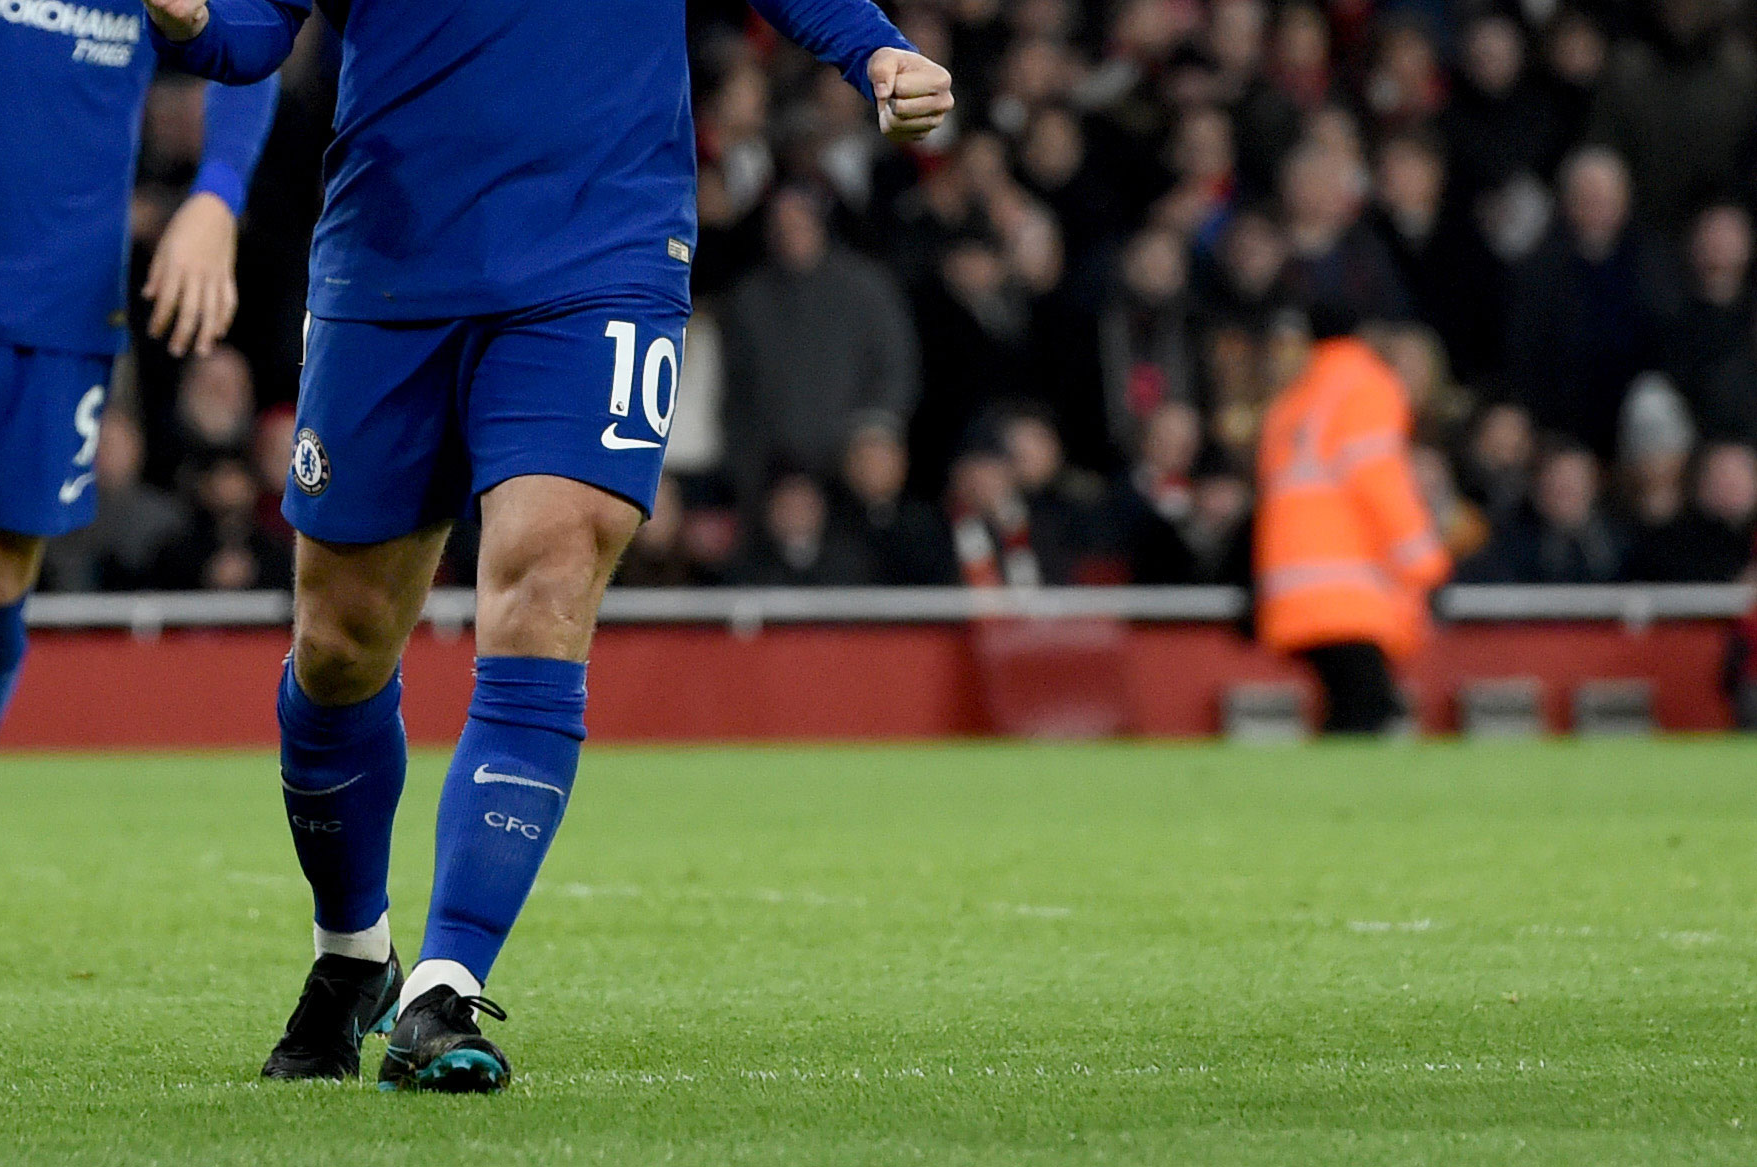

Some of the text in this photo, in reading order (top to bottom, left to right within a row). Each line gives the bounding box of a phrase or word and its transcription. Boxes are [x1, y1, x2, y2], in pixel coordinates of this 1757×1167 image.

[604, 320, 678, 439] 10
[292, 814, 343, 834] CFC
[484, 811, 541, 840] CFC
